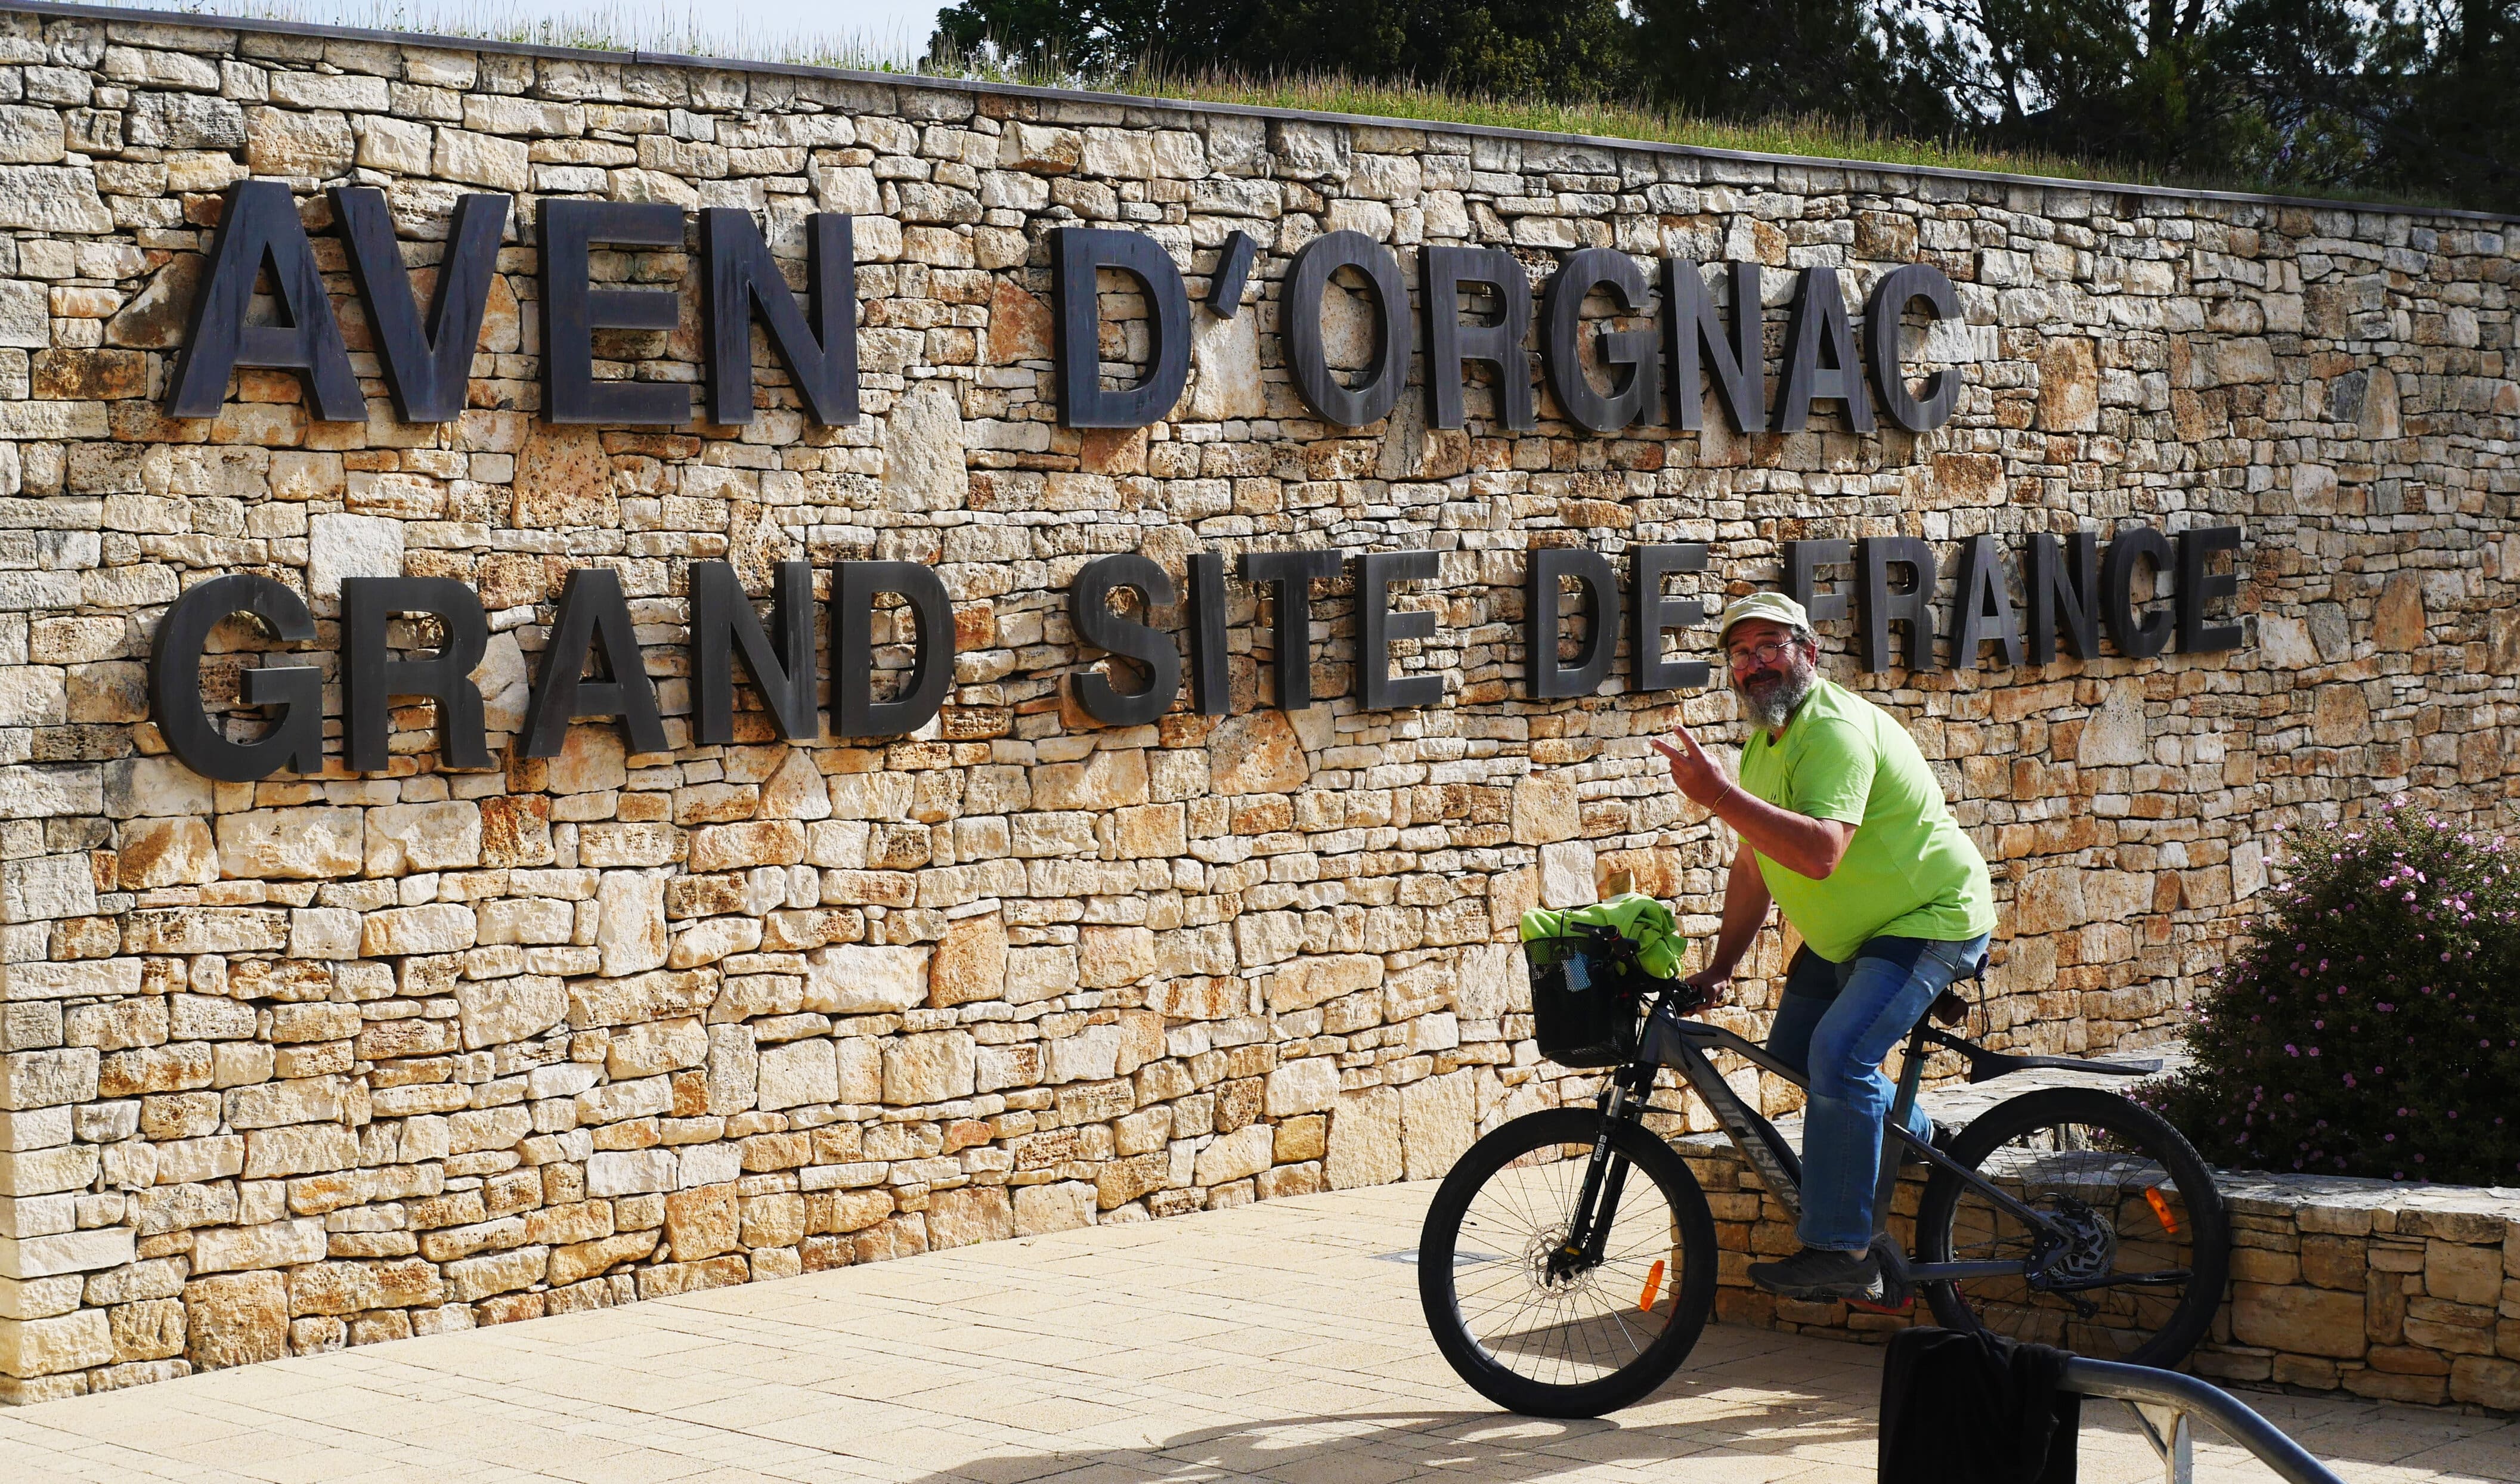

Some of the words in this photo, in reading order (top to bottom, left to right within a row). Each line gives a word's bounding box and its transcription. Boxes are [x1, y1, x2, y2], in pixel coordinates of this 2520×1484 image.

[164, 181, 860, 425] AVEN
[1053, 228, 1961, 434] D'ORGNAC
[149, 560, 954, 783] GRAND
[1070, 549, 1443, 726] SITE
[1527, 542, 1711, 699] DE
[1782, 526, 2243, 673] FRANCE
